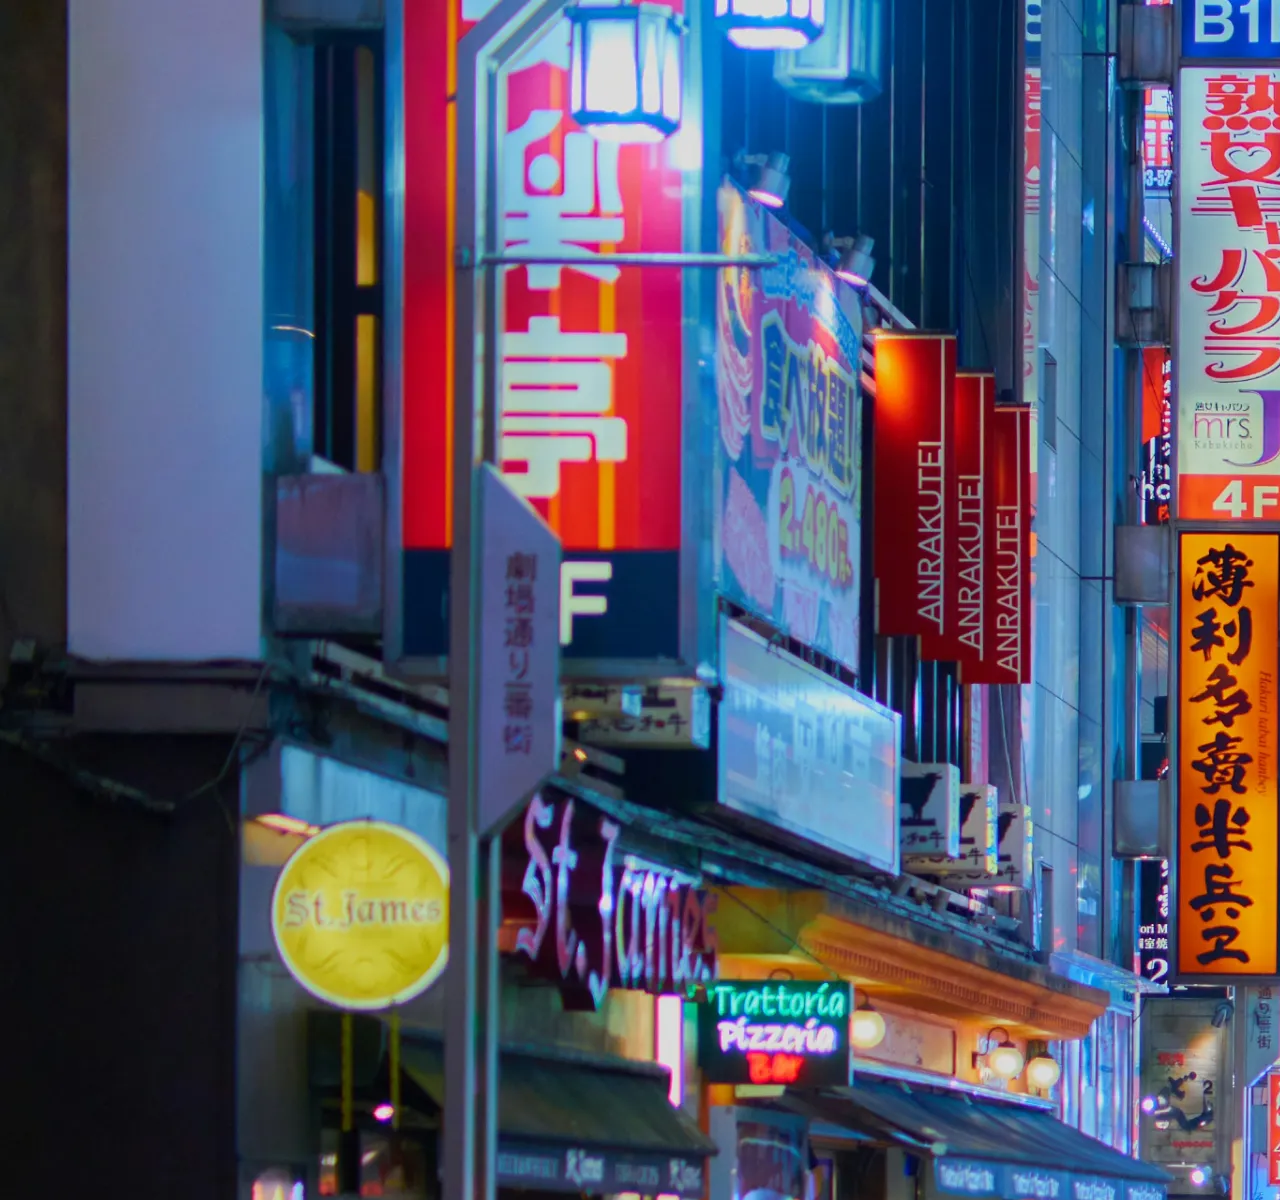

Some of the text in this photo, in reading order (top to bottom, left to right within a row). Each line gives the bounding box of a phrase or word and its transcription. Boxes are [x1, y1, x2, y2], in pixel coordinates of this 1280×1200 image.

[917, 440, 943, 624] ANRAKUTEI
[1212, 480, 1279, 518] 4F
[958, 473, 983, 651] ANRAKUTEI
[997, 504, 1020, 675] ANRAKUTEI
[504, 551, 538, 756] 劇場通り一番街
[338, 891, 444, 930] James
[715, 982, 845, 1019] Trattoria
[718, 1017, 837, 1053] Pizzeria
